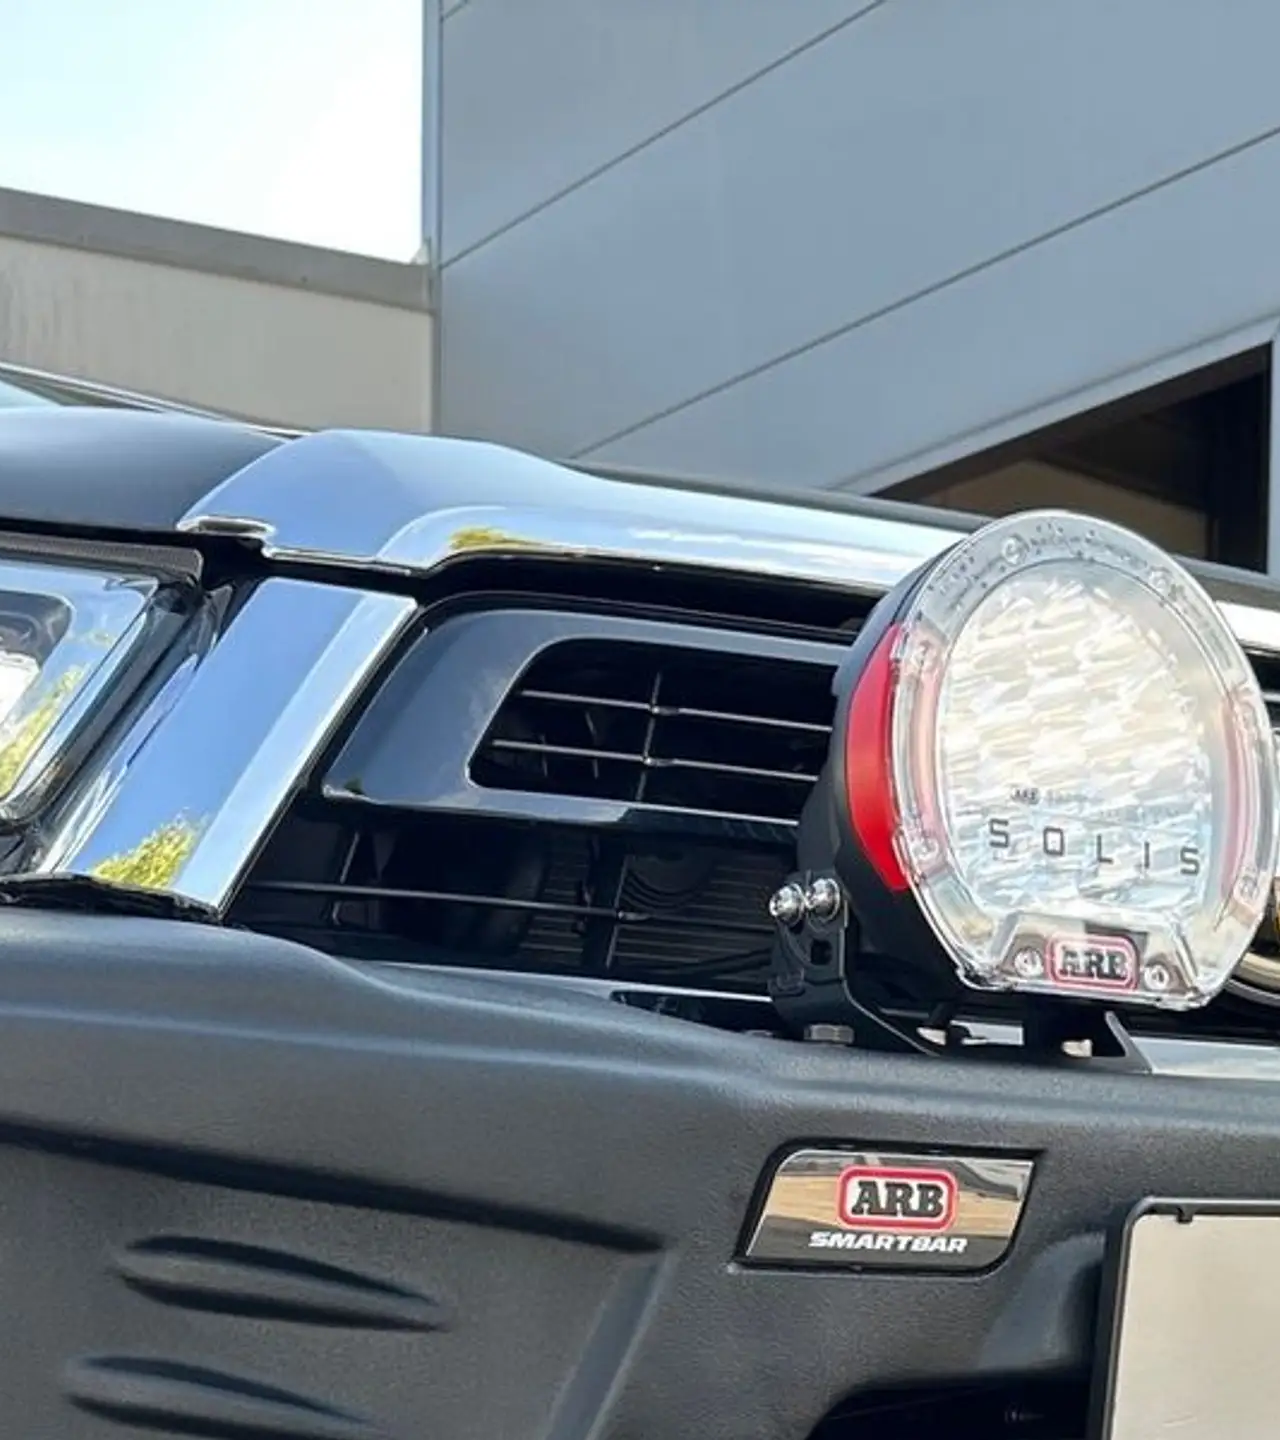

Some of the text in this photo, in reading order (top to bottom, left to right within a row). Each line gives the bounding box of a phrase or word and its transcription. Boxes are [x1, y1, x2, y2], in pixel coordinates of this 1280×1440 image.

[988, 818, 1201, 876] SOLIS
[851, 1180, 944, 1219] ARB
[808, 1230, 969, 1254] SMARTBAR
